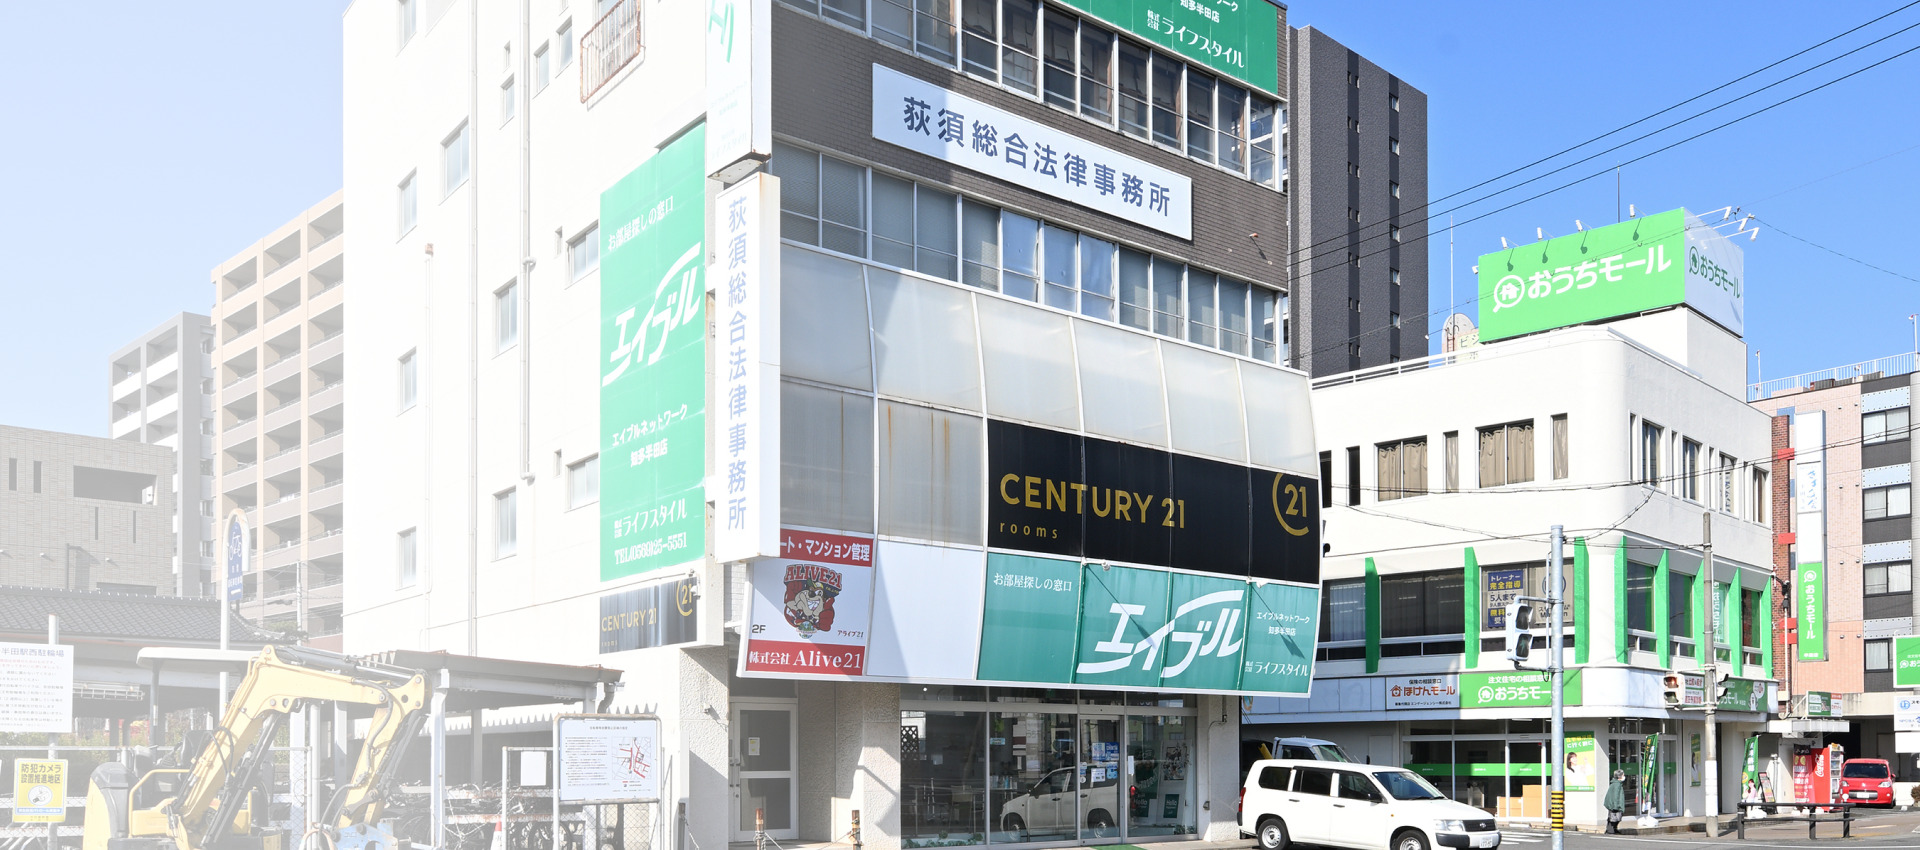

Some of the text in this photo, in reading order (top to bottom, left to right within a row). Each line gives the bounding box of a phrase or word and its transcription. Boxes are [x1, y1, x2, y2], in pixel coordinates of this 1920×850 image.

[1180, 0, 1220, 23] 知多半田店
[1162, 17, 1245, 68] ライフスタイル
[903, 96, 1170, 216] 荻須総合法律事務所
[607, 195, 674, 250] お部屋探しの窓口
[1528, 244, 1672, 299] おうちモール
[1700, 254, 1741, 299] おうちモール
[602, 241, 702, 387] エイブル
[728, 196, 747, 531] 荻須総合法律事務所
[611, 403, 688, 446] エイブルネットワーク
[630, 438, 668, 467] 知多半田店
[1000, 473, 1185, 529] CENTURY 21
[622, 498, 688, 536] ライフスタイル
[1000, 522, 1058, 540] rooms
[785, 565, 841, 589] ALIVE21
[993, 571, 1073, 593] お部屋探しの窓口
[1490, 573, 1521, 582] トレーナー
[601, 607, 657, 633] CENTURY 21
[1256, 611, 1311, 624] エイブルネットワーク
[1805, 584, 1817, 640] おうちモール
[752, 624, 766, 634] 2F
[1076, 589, 1244, 678] エイブル
[749, 649, 862, 669] 株式会社 Alive21
[1255, 662, 1309, 677] ライフスタイル
[1403, 685, 1456, 697] ほけんモール
[1495, 686, 1551, 700] おうちモー
[21, 763, 61, 774] 防犯カメラ
[21, 774, 61, 784] 設置推進地区
